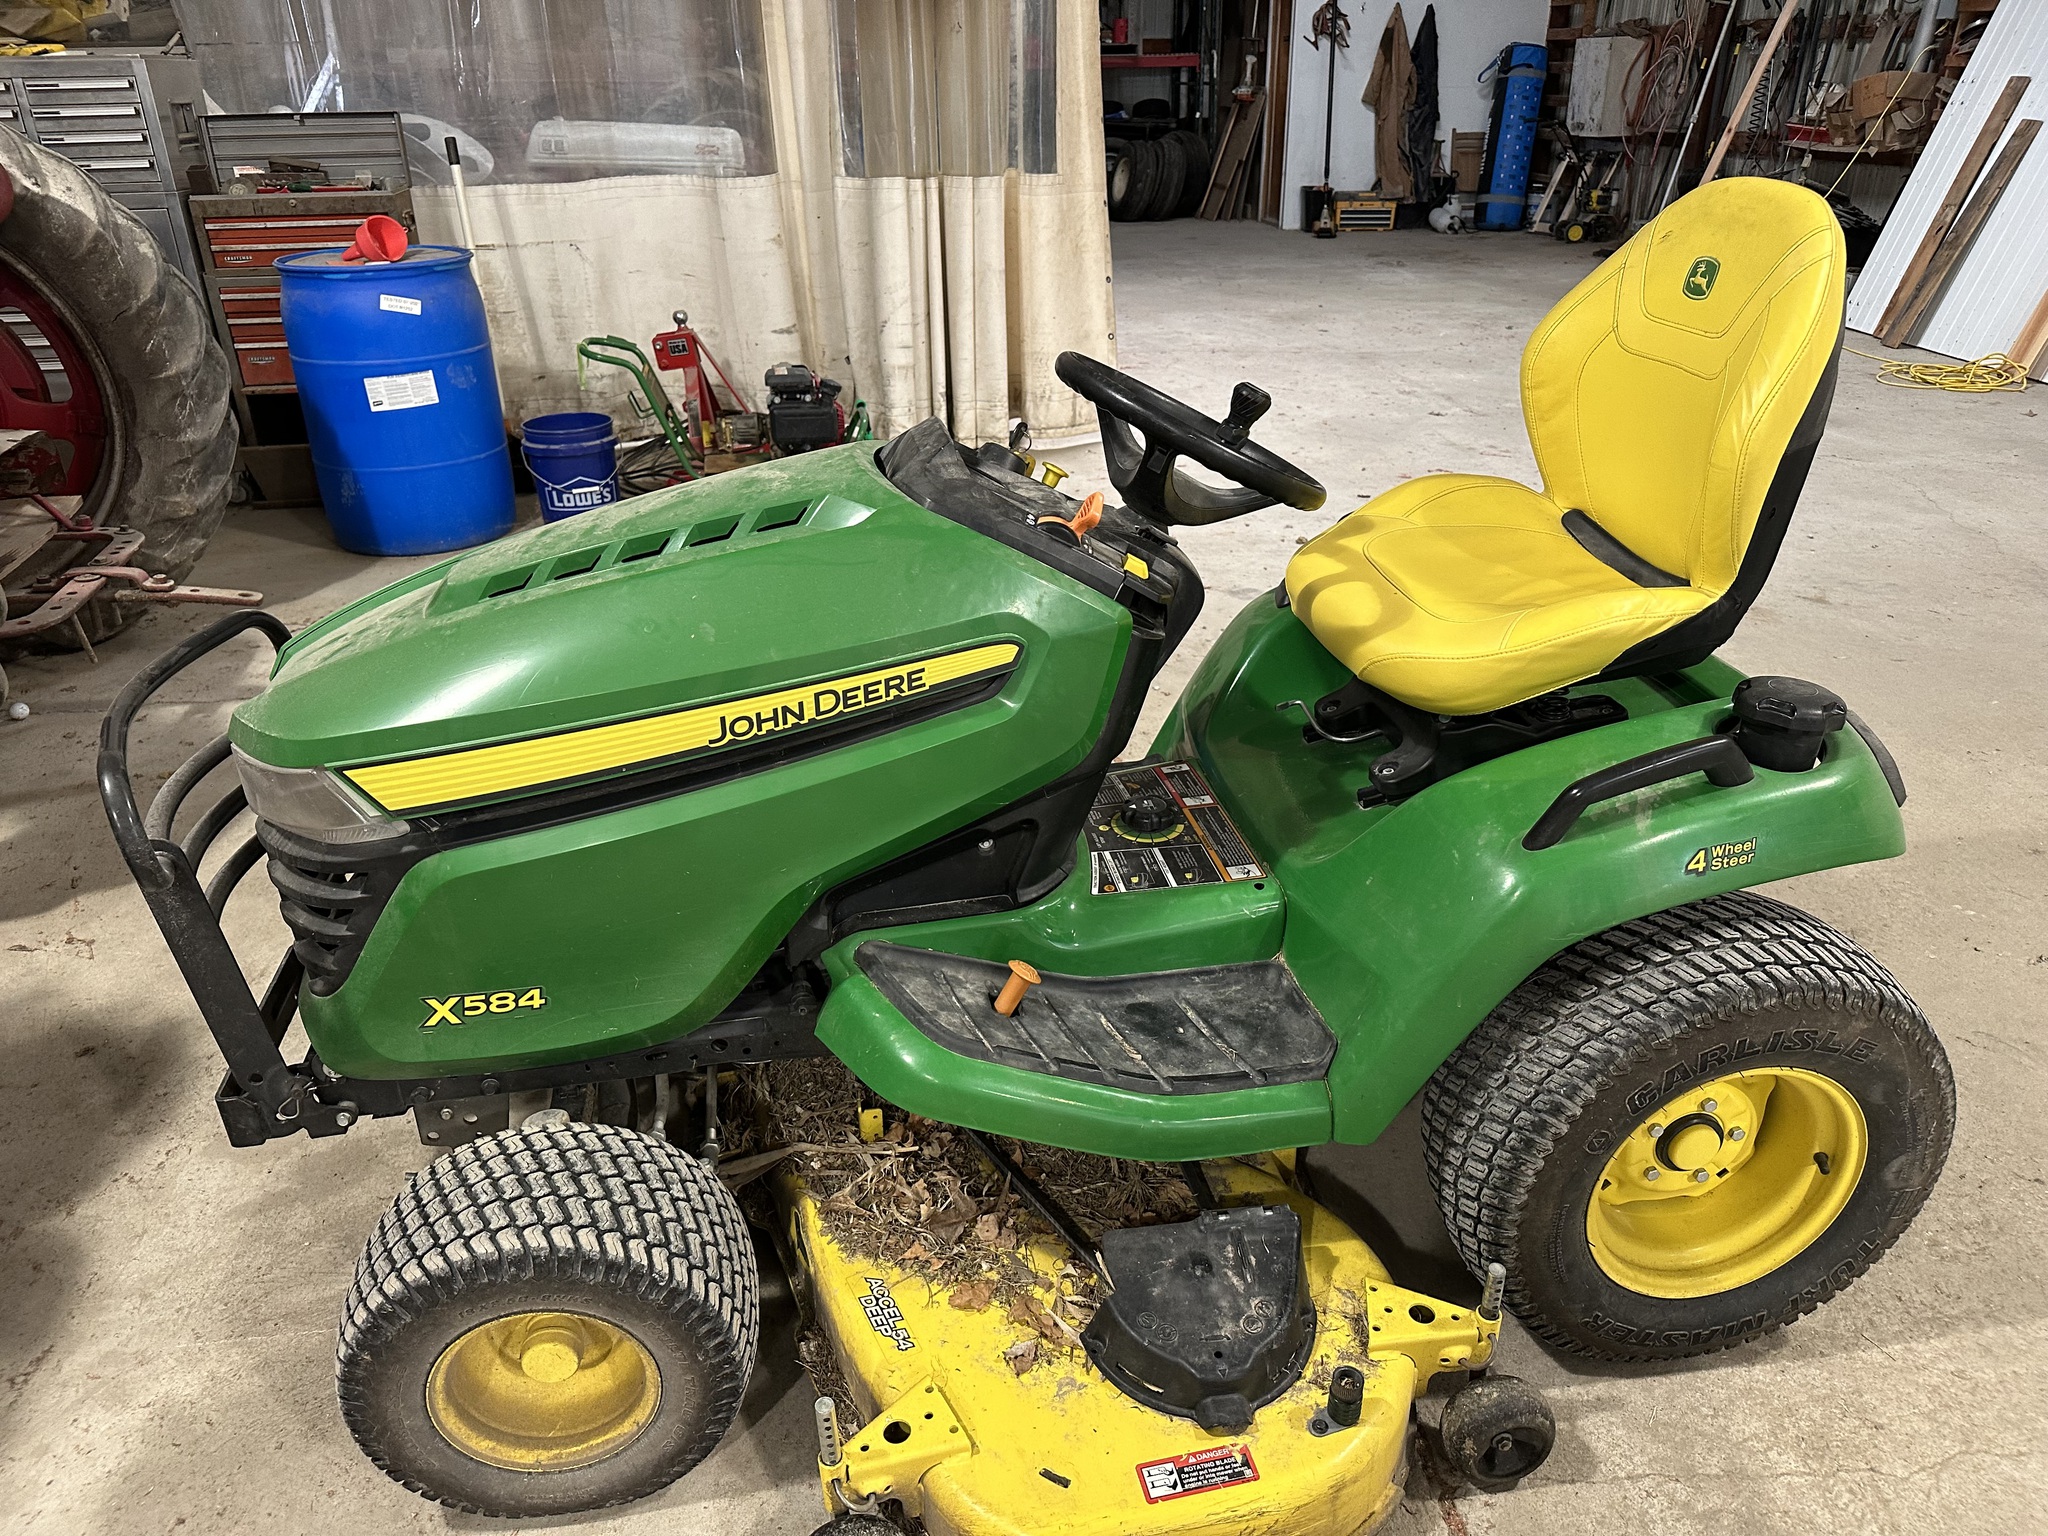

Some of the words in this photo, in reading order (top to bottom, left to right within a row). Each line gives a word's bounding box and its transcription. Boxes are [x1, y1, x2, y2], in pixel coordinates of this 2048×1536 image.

[670, 344, 688, 354] USA
[552, 487, 612, 507] LOWE'S
[708, 705, 805, 745] JOHN
[814, 667, 926, 717] DEERE
[1686, 849, 1707, 873] 4
[1711, 837, 1757, 858] Wheel
[1710, 852, 1755, 871] Steer
[421, 987, 547, 1028] X584
[1625, 1029, 1879, 1116] CARLISLE
[858, 1294, 893, 1337] DEEP
[1578, 1310, 1767, 1348] MASTER
[1196, 1448, 1230, 1461] DANGER
[1182, 1475, 1198, 1484] under
[1216, 1469, 1234, 1477] mower
[1233, 1465, 1248, 1473] when
[1183, 1461, 1216, 1473] ROTATING
[1199, 1469, 1208, 1477] put
[1208, 1465, 1224, 1474] hands
[1184, 1481, 1202, 1490] engine
[1208, 1475, 1229, 1484] running
